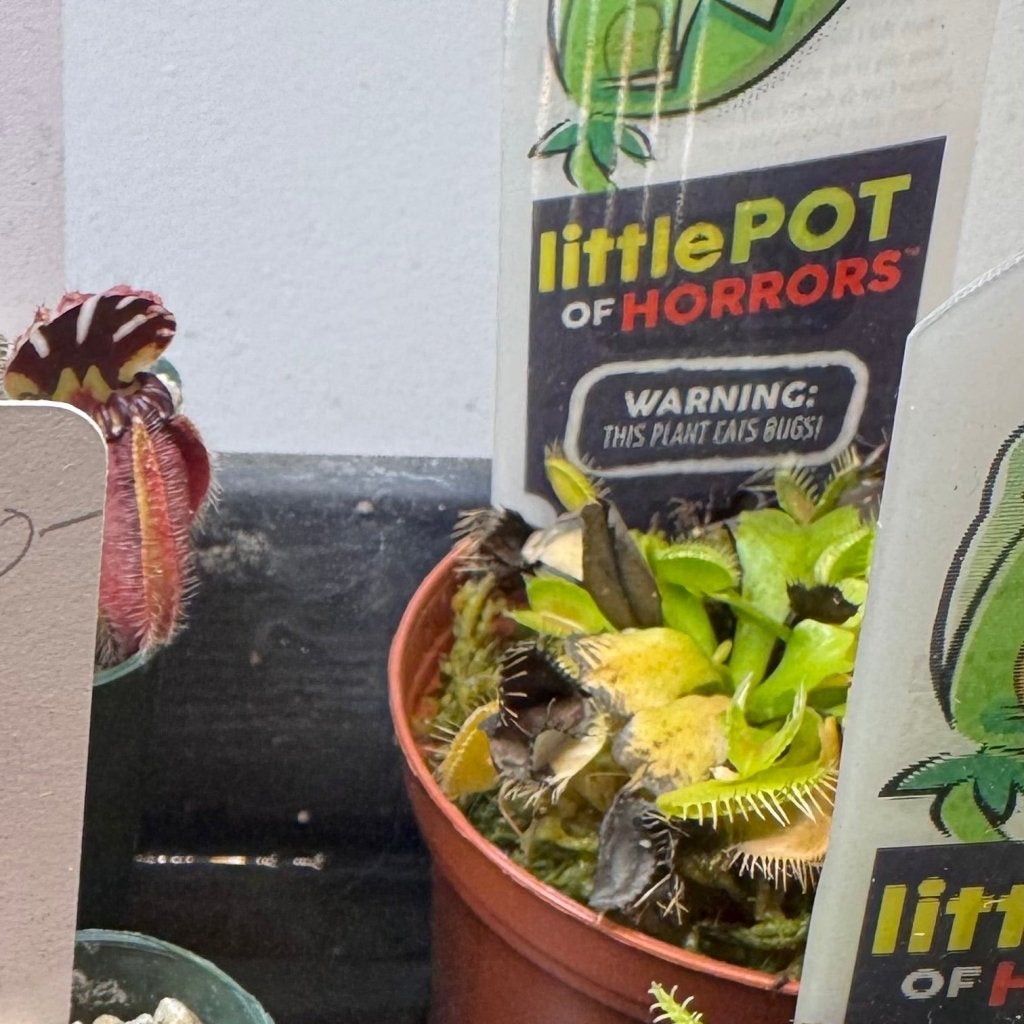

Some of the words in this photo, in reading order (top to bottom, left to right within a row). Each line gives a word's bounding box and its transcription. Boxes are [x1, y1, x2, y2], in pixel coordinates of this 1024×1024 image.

[561, 297, 616, 329] OF
[621, 249, 902, 332] HORRORS
[625, 380, 819, 418] WARNING:
[603, 422, 647, 449] THIS
[649, 419, 711, 448] PLANT
[762, 414, 824, 443] BUGS!
[901, 966, 982, 1000] OF
